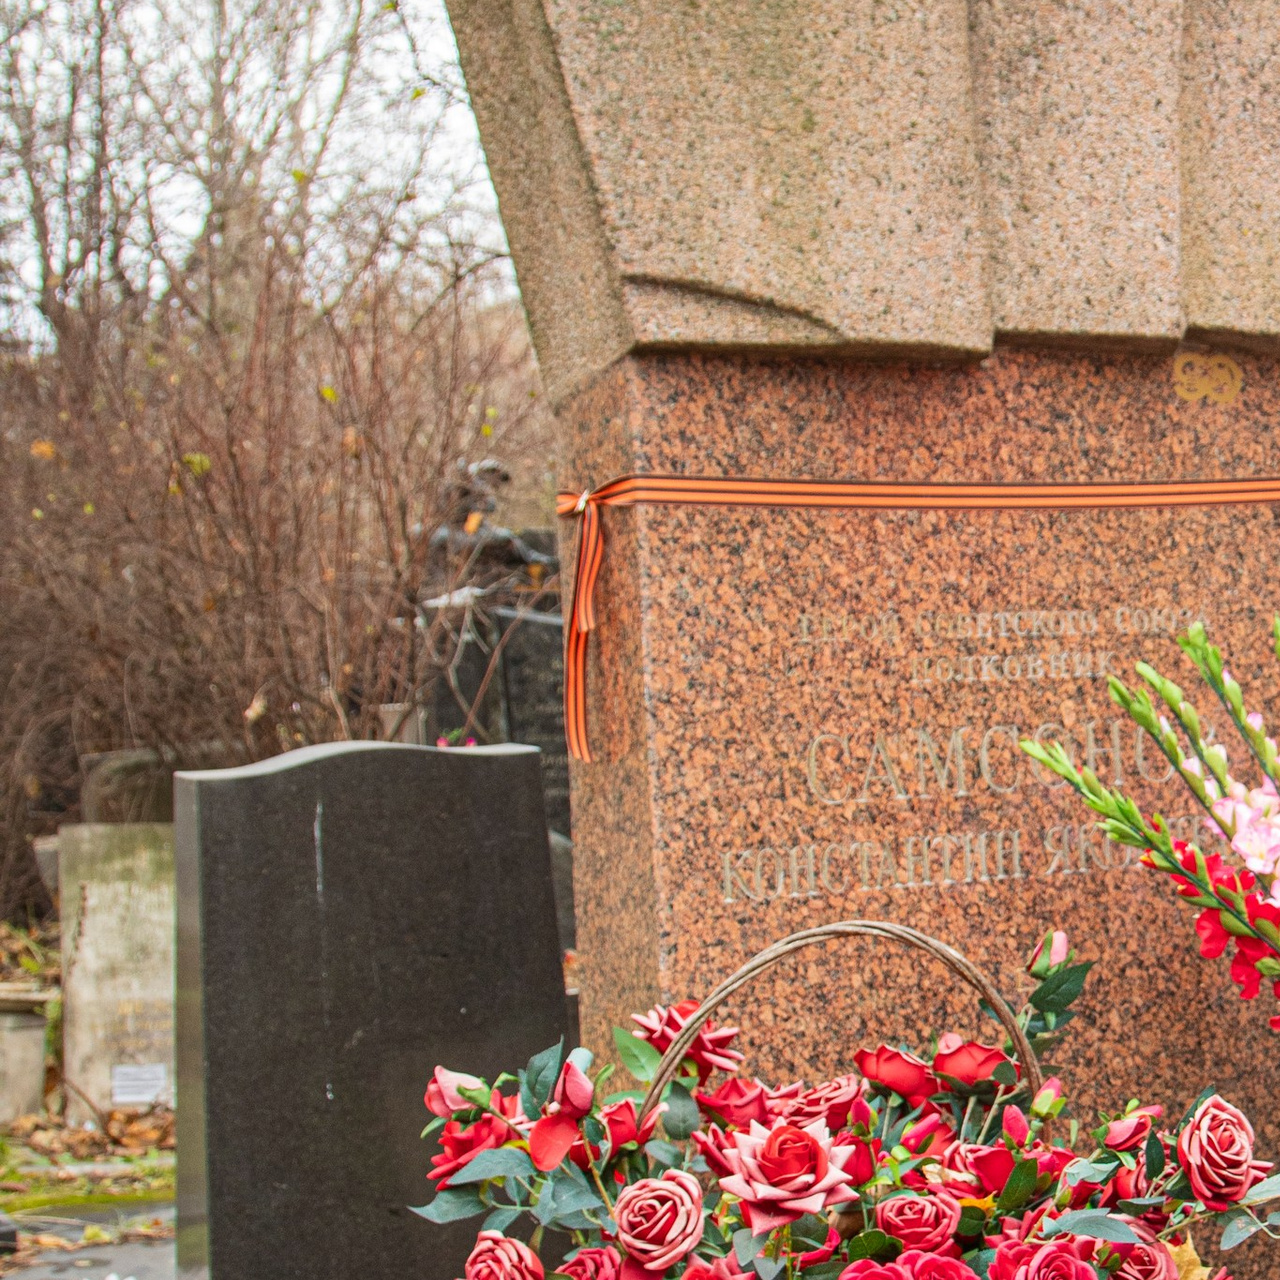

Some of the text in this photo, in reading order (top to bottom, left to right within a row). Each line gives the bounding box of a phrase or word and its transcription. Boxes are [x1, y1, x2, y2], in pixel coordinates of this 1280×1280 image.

[914, 609, 1098, 638] СОВЕТСКОГО
[911, 651, 1119, 683] ПОЛКОВНИК
[807, 715, 1214, 805] САМСОНО
[722, 828, 1021, 903] КОНСТАНТИН
